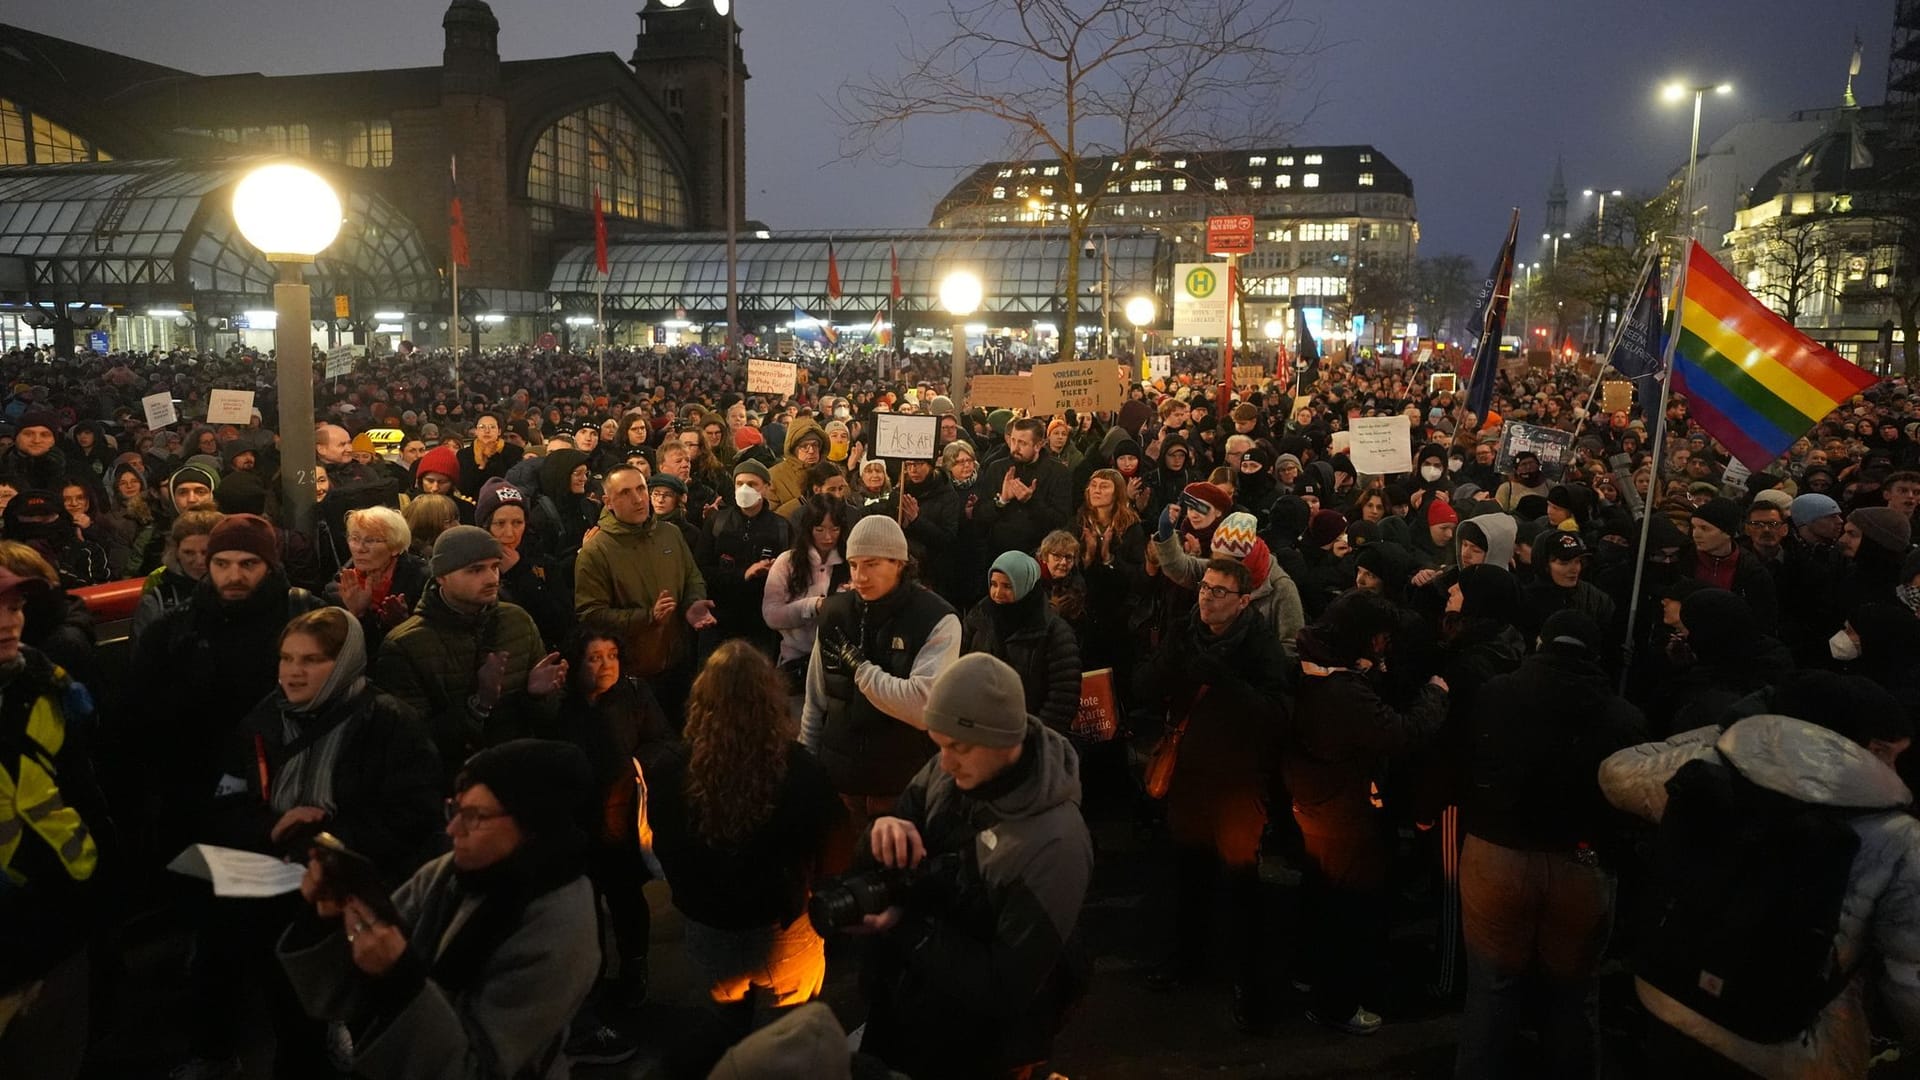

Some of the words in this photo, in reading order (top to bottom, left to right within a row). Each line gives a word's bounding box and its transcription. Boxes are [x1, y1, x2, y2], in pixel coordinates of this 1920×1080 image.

[1194, 274, 1209, 291] H
[1052, 367, 1093, 379] VORSCHLAG
[1054, 379, 1100, 389] ABSCHIEBE-
[1061, 388, 1088, 397] TICKET
